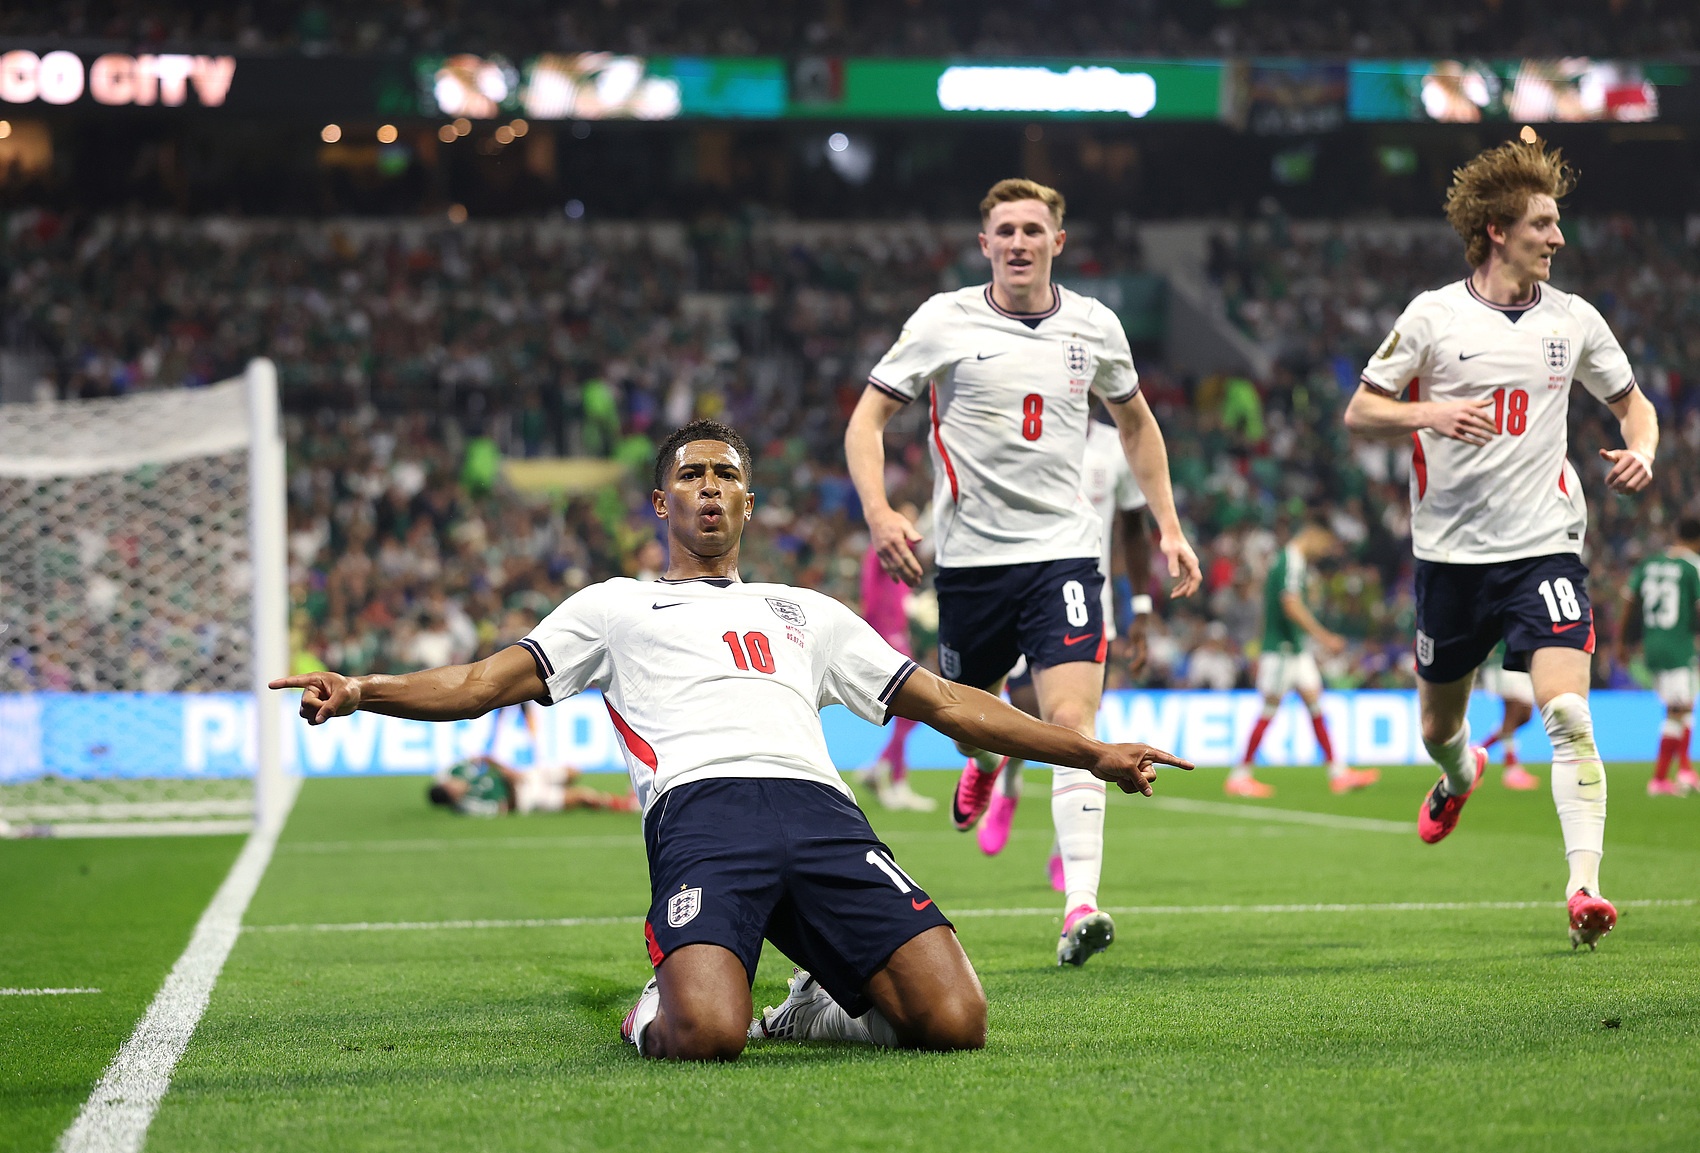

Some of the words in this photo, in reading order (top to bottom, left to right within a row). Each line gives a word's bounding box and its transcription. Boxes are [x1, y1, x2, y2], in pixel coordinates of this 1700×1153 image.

[90, 53, 237, 107] CITY
[1022, 393, 1044, 442] 8
[1493, 388, 1529, 436] 18
[1062, 580, 1089, 627] 8
[1538, 577, 1582, 622] 18
[1641, 579, 1680, 630] 23
[722, 631, 776, 675] 10
[183, 694, 628, 772] POWERAD
